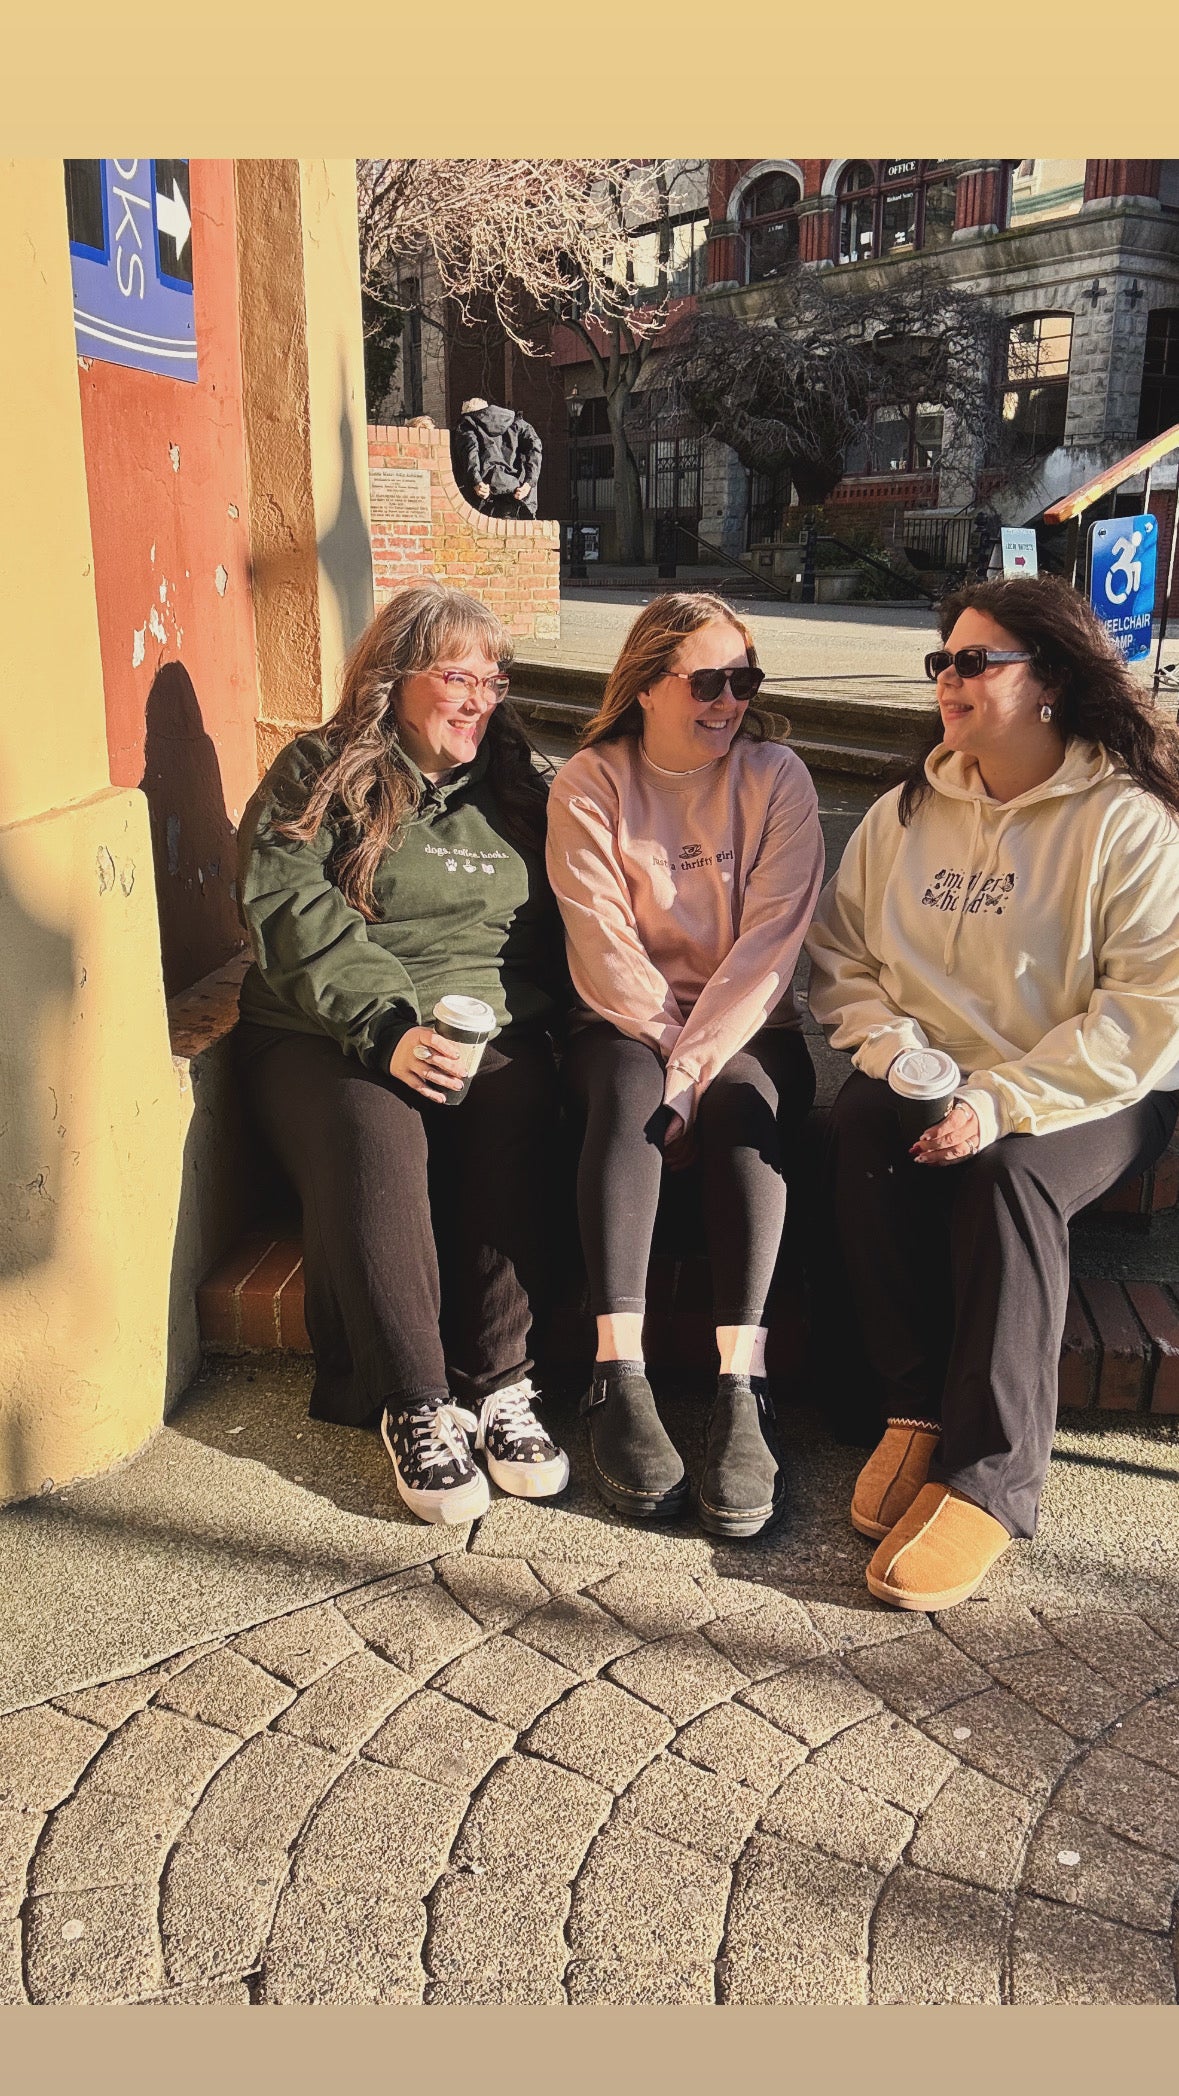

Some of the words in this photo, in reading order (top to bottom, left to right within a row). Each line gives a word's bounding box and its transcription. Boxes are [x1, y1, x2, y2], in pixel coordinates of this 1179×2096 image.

[888, 161, 916, 176] OFFICE
[1104, 613, 1151, 633] EELCHAIR
[1114, 634, 1133, 649] AMP
[424, 844, 451, 857] dogs.
[480, 850, 510, 859] books.
[671, 863, 677, 871] a
[680, 857, 713, 871] thrifty
[715, 850, 734, 863] girl
